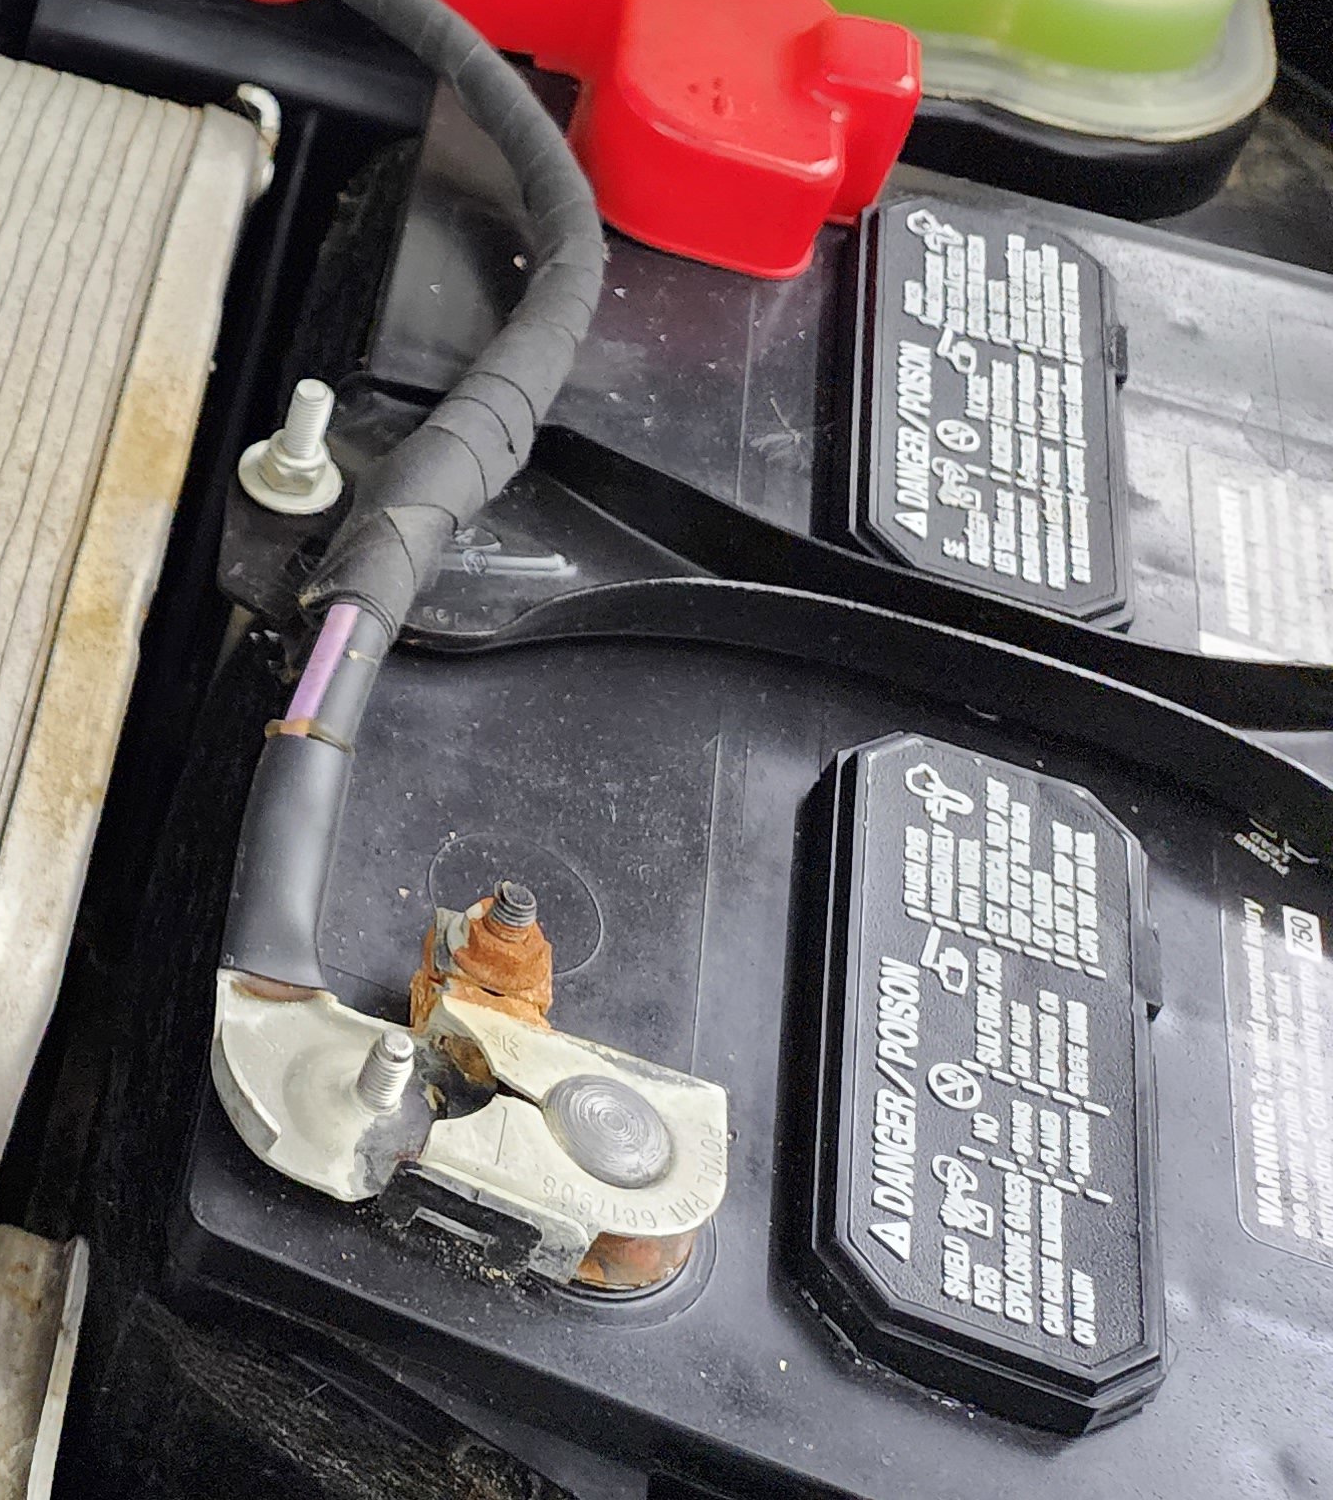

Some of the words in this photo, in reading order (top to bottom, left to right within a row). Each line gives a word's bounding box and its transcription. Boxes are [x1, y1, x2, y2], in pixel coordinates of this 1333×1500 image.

[895, 341, 931, 509] DANGER/POISON
[1290, 916, 1314, 953] 750
[1242, 944, 1271, 1023] personal
[872, 957, 919, 1216] DANGER/POISON
[1251, 1072, 1272, 1093] To
[972, 1113, 1000, 1144] NO
[1251, 1095, 1283, 1227] WARNING:
[1288, 1142, 1308, 1201] owner
[943, 1235, 970, 1299] SHIELD
[974, 1264, 1001, 1313] EYES
[1005, 1231, 1033, 1324] EXPLOSIVE
